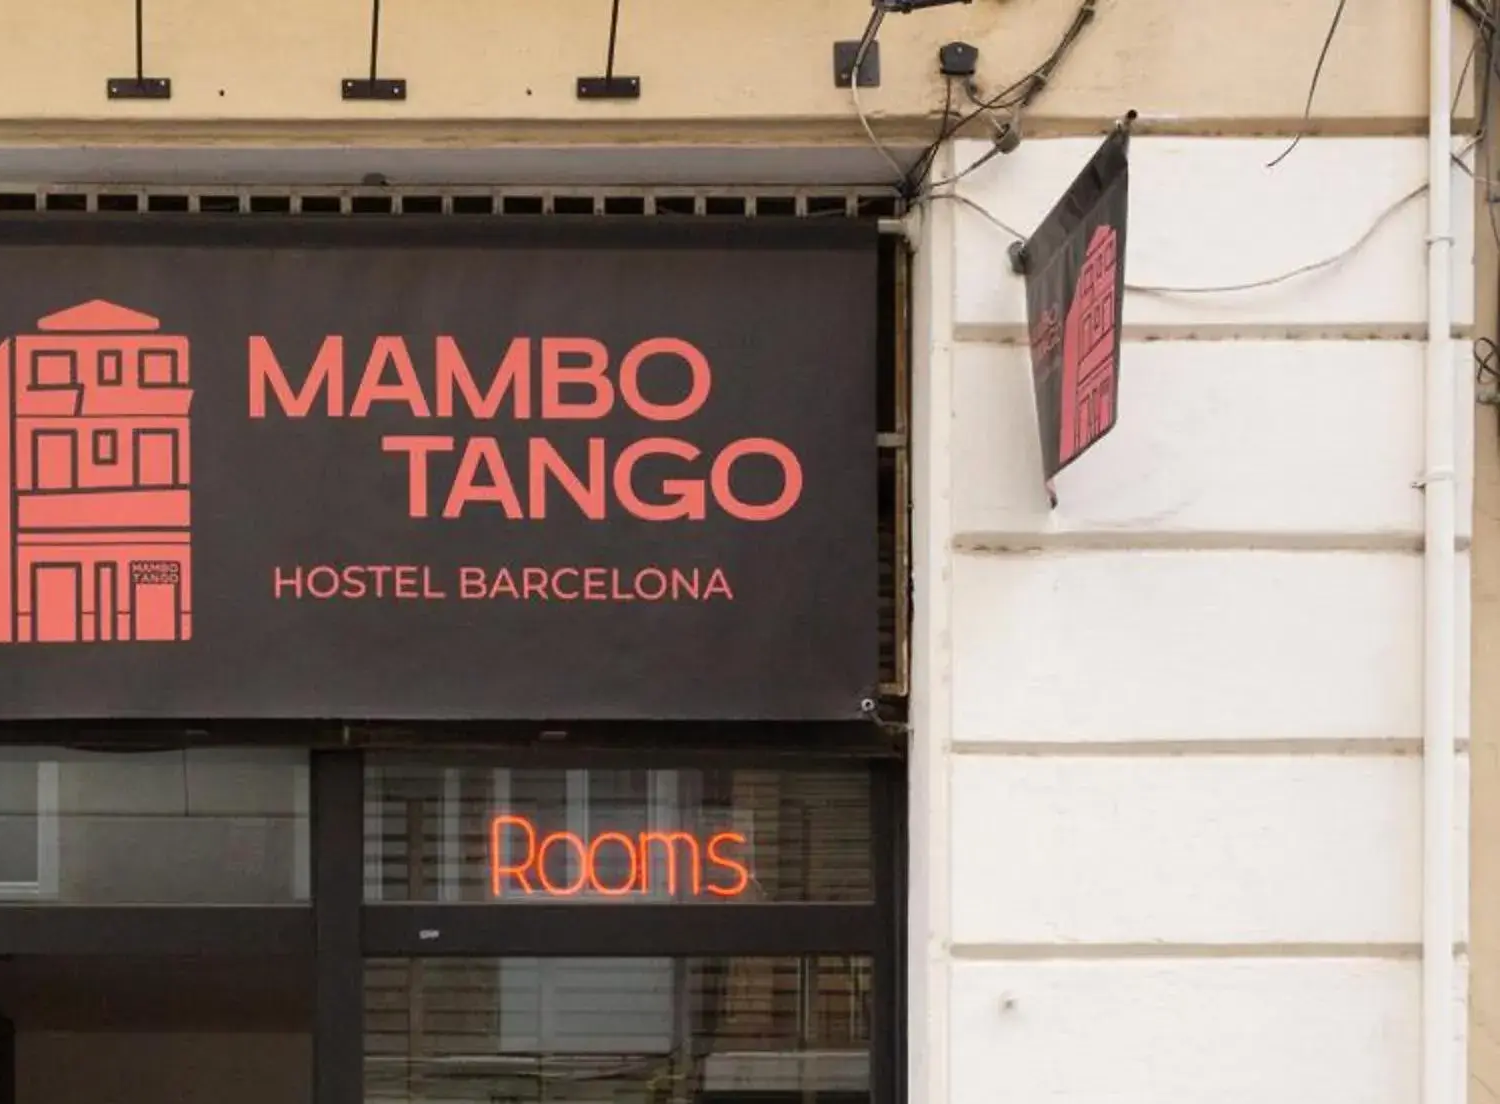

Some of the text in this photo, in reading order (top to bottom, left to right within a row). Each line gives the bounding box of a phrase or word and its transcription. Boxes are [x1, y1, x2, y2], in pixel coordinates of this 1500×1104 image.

[246, 333, 713, 422] MAMBO
[381, 435, 804, 521] TANGO
[132, 562, 179, 573] MAMBO
[132, 573, 179, 583] TANGO
[273, 564, 732, 602] HOSTEL BARCELONA
[489, 814, 751, 899] Rooms
